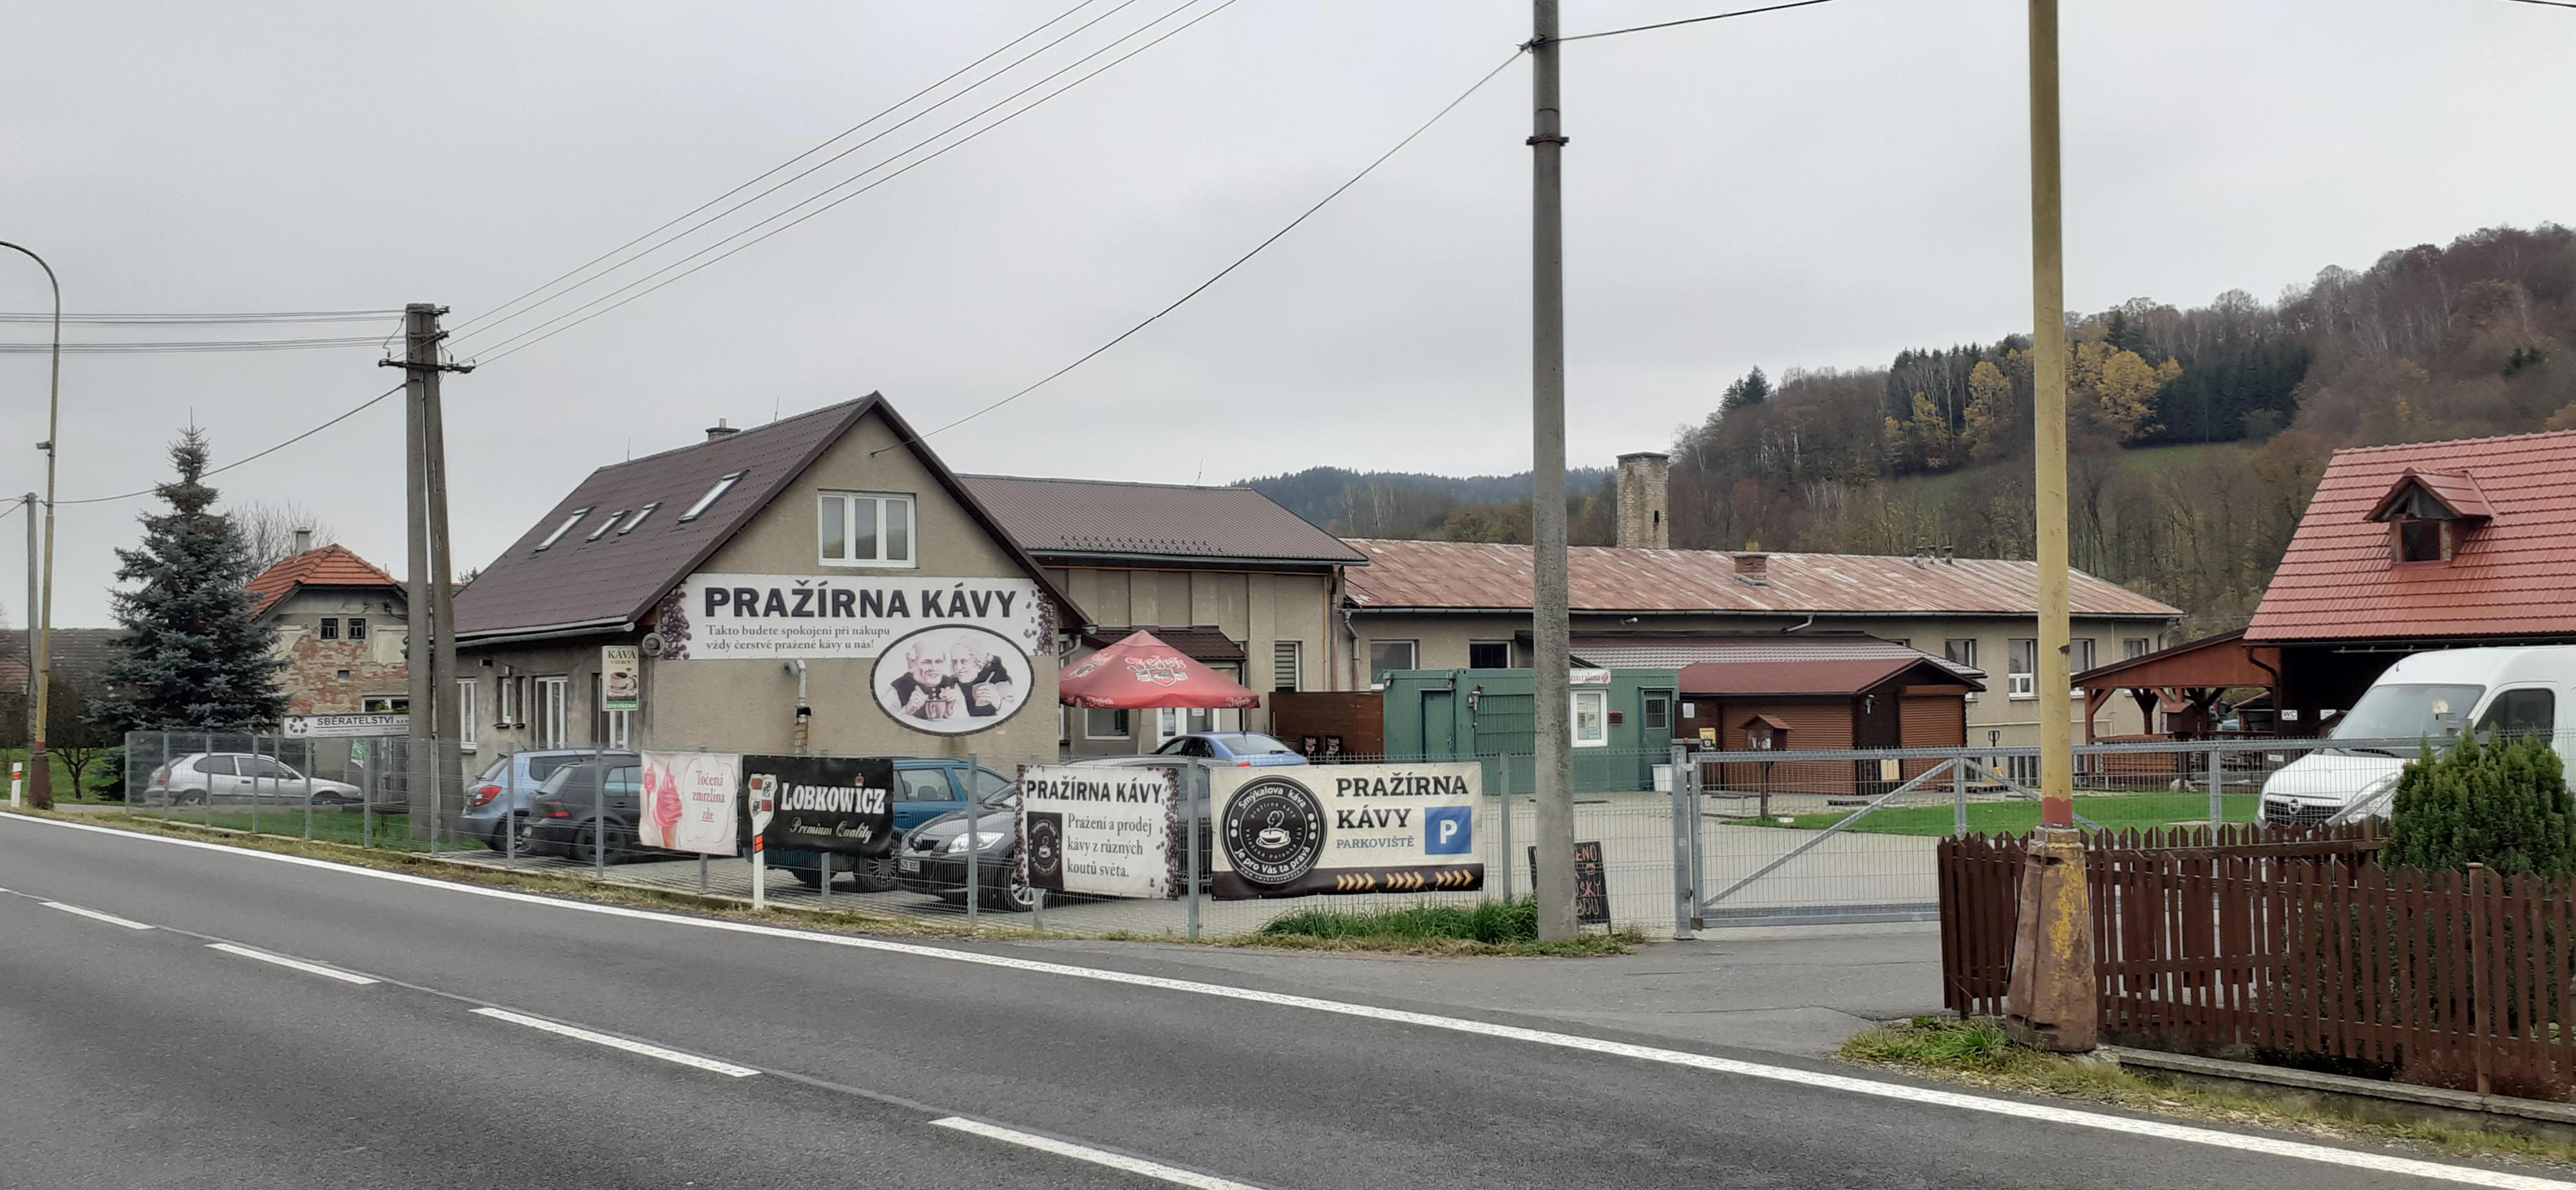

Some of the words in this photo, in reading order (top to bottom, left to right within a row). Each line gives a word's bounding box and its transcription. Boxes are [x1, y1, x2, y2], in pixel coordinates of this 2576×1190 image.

[705, 580, 910, 618] PRAŽÍRNA
[922, 583, 1017, 618] KÁVY
[706, 625, 739, 636] Takto
[742, 625, 779, 636] budete
[835, 626, 850, 639] při
[852, 625, 890, 639] nákupu
[608, 648, 636, 659] KÁVA
[706, 639, 732, 652] vždy
[734, 641, 772, 650] čerstvě
[775, 640, 817, 653] pražené
[819, 639, 843, 652] kávy
[854, 639, 875, 649] nás!
[317, 714, 393, 726] SBĚRATELSTVÍ
[696, 770, 723, 786] Točená
[1026, 775, 1111, 802] PRAŽÍRNA
[1116, 777, 1162, 804] KÁVY
[1336, 771, 1468, 798] PRAŽÍRNA
[692, 788, 725, 803] zmrzlina
[781, 782, 886, 815] LOBKOWICZ
[1238, 786, 1283, 809] Smýkalova
[1288, 789, 1307, 809] káva
[702, 807, 714, 820] zde
[1068, 813, 1107, 830] Pražení
[1109, 820, 1115, 830] a
[1117, 816, 1152, 837] prodej
[1336, 804, 1412, 829] KÁVY
[790, 817, 833, 836] Premium
[837, 820, 873, 844] Quality
[1440, 820, 1458, 844] P
[1067, 836, 1091, 856] kávy
[1101, 839, 1143, 859] různých
[1336, 836, 1415, 849] PARKOVIŠTĚ
[1067, 858, 1096, 874] koutů
[1099, 866, 1129, 878] světa.
[1234, 848, 1245, 858] je
[1243, 858, 1259, 871] pro
[1262, 864, 1277, 874] Vás
[1290, 846, 1311, 869] pravá
